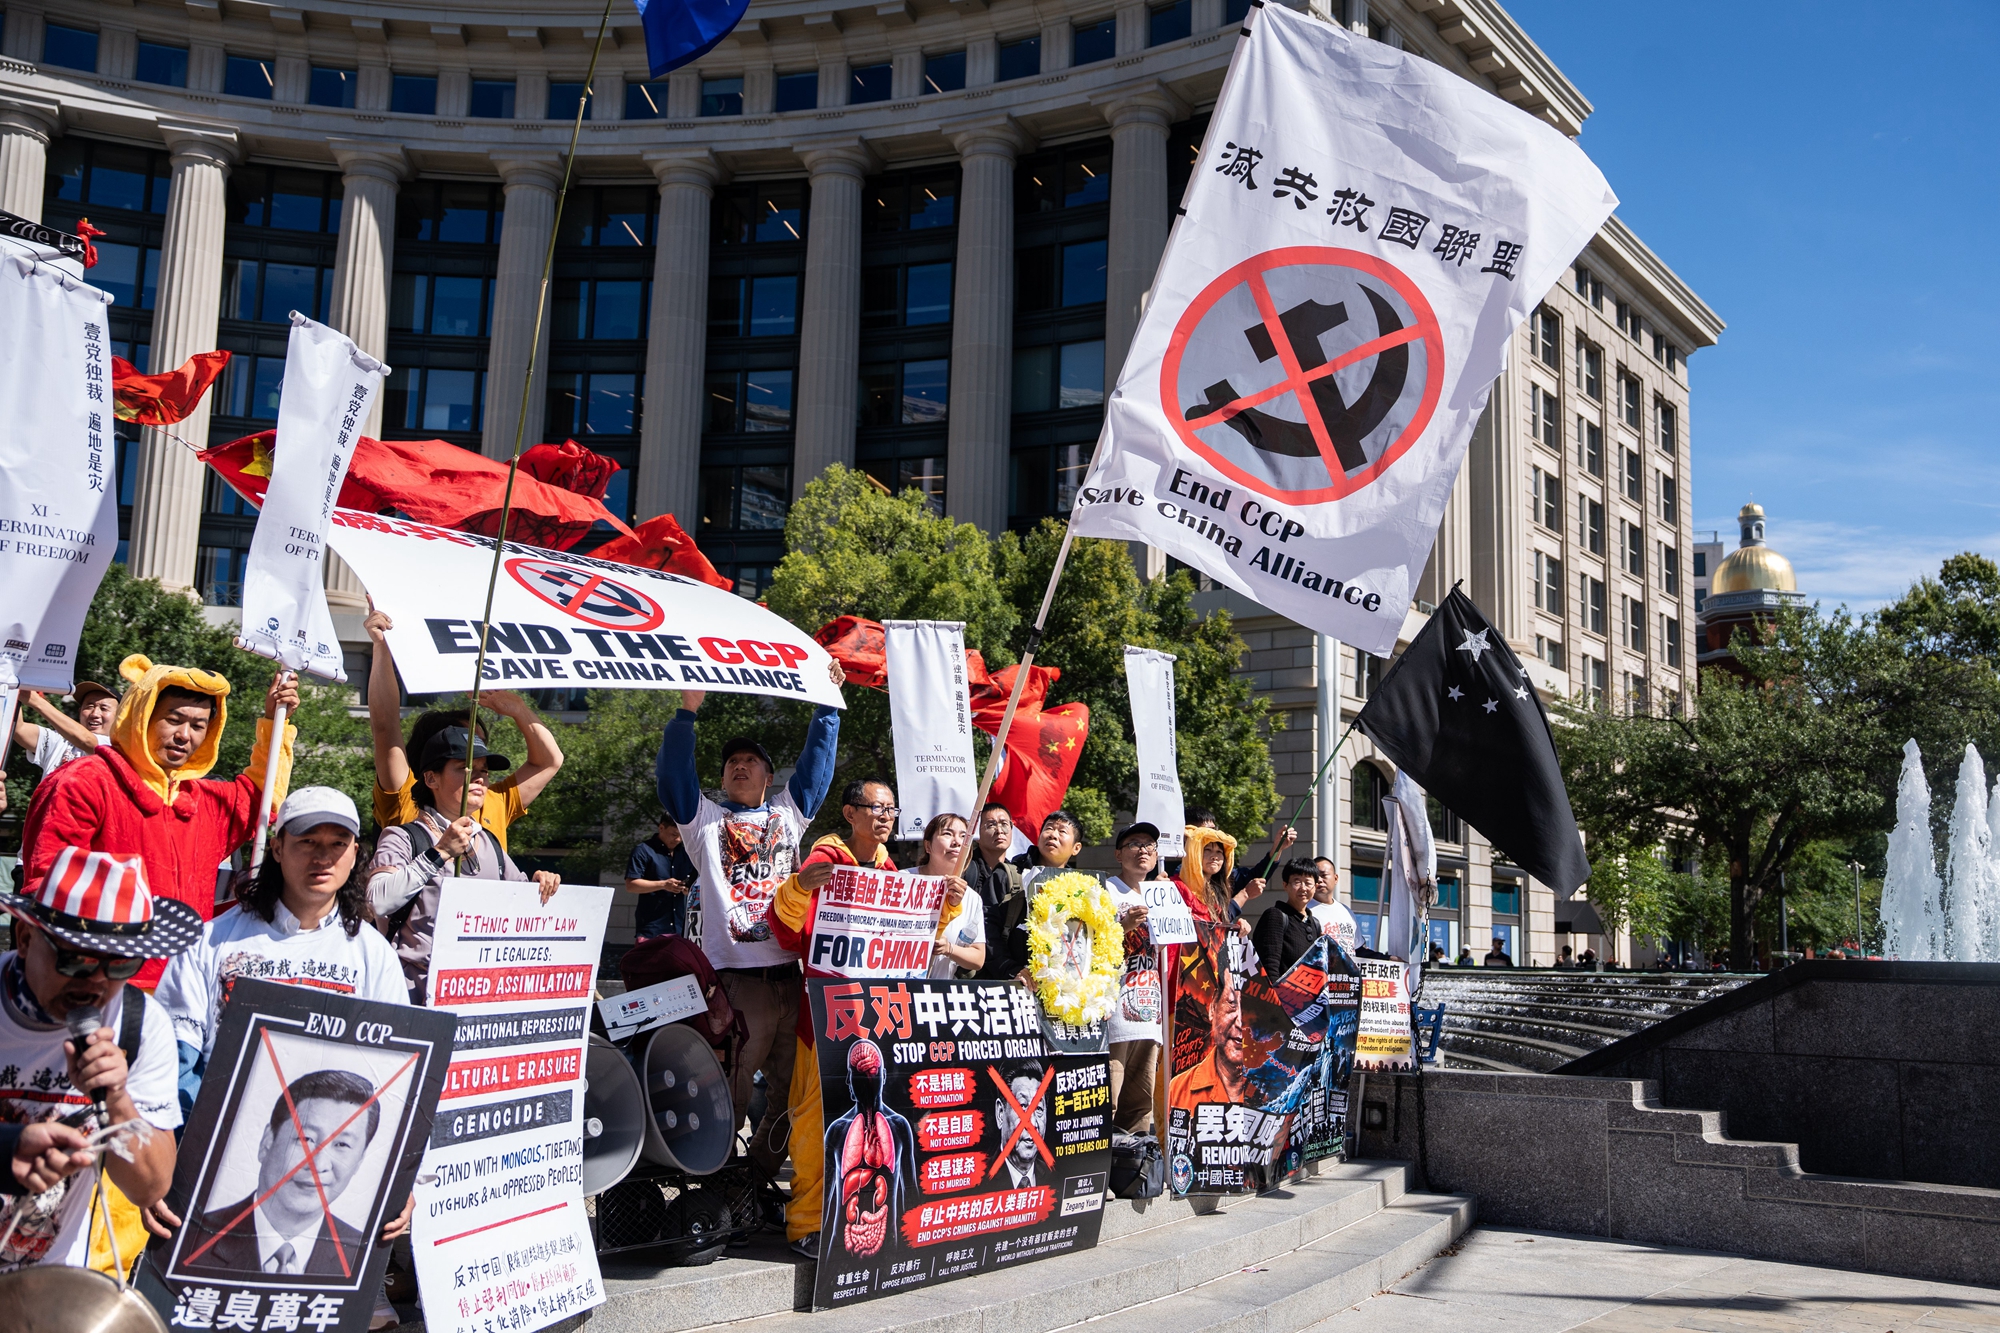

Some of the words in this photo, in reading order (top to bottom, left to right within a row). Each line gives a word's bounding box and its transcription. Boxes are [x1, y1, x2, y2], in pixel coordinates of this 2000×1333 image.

[84, 321, 104, 403] 壹党独裁
[87, 411, 104, 493] 遍地是灾
[30, 503, 48, 518] XI
[1169, 468, 1232, 512] End
[1240, 499, 1305, 542] CCP
[0, 518, 96, 546] ERMINATOR
[0, 539, 11, 552] F
[15, 541, 90, 565] FREEDOM
[284, 543, 304, 557] OF
[1078, 487, 1145, 507] Save
[1157, 502, 1243, 559] China
[1250, 545, 1382, 613] Alliance
[424, 618, 572, 655] END
[571, 627, 703, 663] THE
[698, 637, 809, 670] CCP
[475, 658, 569, 681] SAVE
[572, 659, 675, 682] CHINA
[683, 665, 808, 694] ALLIANCE
[914, 755, 966, 763] TERMINATOR
[916, 765, 928, 773] OF
[930, 765, 966, 774] FREEDOM
[731, 863, 771, 885] END
[730, 880, 775, 903] CCP
[1144, 887, 1167, 909] CCP
[748, 902, 764, 912] CCP
[555, 918, 578, 932] LAW
[818, 911, 845, 922] FREEDOM
[846, 914, 877, 926] DEMOCRACY
[879, 917, 897, 929] HUMAN
[478, 947, 491, 963] IT
[495, 946, 552, 962] LEGALIZES:
[811, 933, 866, 968] FOR
[866, 937, 930, 970] CHINA
[1126, 955, 1154, 973] END
[440, 975, 491, 999] FORCED
[495, 971, 584, 995] ASSIMILATION
[1125, 969, 1154, 988] CCP
[304, 1011, 347, 1038] END
[355, 1020, 393, 1045] CCP
[453, 1021, 519, 1043] NSNATIONAL
[521, 1014, 583, 1036] REPRESSION
[1330, 1009, 1357, 1026] NEVER
[1175, 1027, 1192, 1046] CCP
[893, 1043, 926, 1064] STOP
[929, 1041, 956, 1062] CCP
[958, 1040, 1003, 1061] FORCED
[1005, 1038, 1040, 1058] ORGAN
[1172, 1037, 1204, 1062] EXPORTS
[441, 1063, 510, 1093] ULTURAL
[517, 1054, 577, 1080] ERASURE
[1175, 1051, 1199, 1074] DEATH
[916, 1072, 966, 1093] 不是捐献
[1055, 1063, 1107, 1094] 反对习近平
[920, 1095, 932, 1105] NOT
[934, 1093, 964, 1103] DONATION
[453, 1101, 544, 1138] GENOCIDE
[925, 1114, 973, 1136] 不是自愿
[1056, 1119, 1071, 1132] STOP
[1072, 1118, 1079, 1129] XI
[1079, 1114, 1103, 1128] JINPING
[930, 1138, 942, 1148] NOT
[943, 1135, 970, 1146] CONSENT
[1062, 1130, 1080, 1143] FROM
[1080, 1127, 1100, 1140] LIVING
[1055, 1146, 1064, 1157] TO
[1064, 1144, 1075, 1155] 150
[1076, 1140, 1095, 1154] YEARS
[1095, 1138, 1109, 1150] OLD!
[434, 1161, 471, 1189] STAND
[473, 1155, 498, 1177] WITH
[927, 1156, 975, 1179] 这是谋杀
[429, 1191, 479, 1218] UYGHURS
[481, 1186, 488, 1203] &
[489, 1187, 501, 1200] ALL
[502, 1174, 546, 1199] OPPRESSED
[547, 1163, 582, 1188] PEOPLES!
[932, 1181, 938, 1191] IT
[939, 1180, 945, 1190] IS
[946, 1177, 971, 1188] MURDER
[1065, 1199, 1085, 1212] Zegang
[1085, 1198, 1099, 1208] Yuan
[917, 1229, 931, 1243] END
[932, 1226, 952, 1241] CCP'S
[952, 1223, 977, 1236] CRIMES
[977, 1219, 1003, 1234] AGAINST
[1004, 1211, 1037, 1229] HUMANITY!
[1001, 1252, 1016, 1262] WORLD
[1016, 1249, 1035, 1260] WITHOUT
[1034, 1246, 1050, 1256] ORGAN
[1050, 1240, 1073, 1254] TRAFFICKING
[938, 1266, 950, 1276] CALL
[950, 1264, 960, 1274] FOR
[960, 1261, 977, 1273] JUSTICE
[881, 1277, 900, 1289] OPPOSE
[900, 1272, 926, 1286] ATROCITIES
[833, 1287, 856, 1300] RESPECT
[856, 1285, 868, 1296] LIFE
